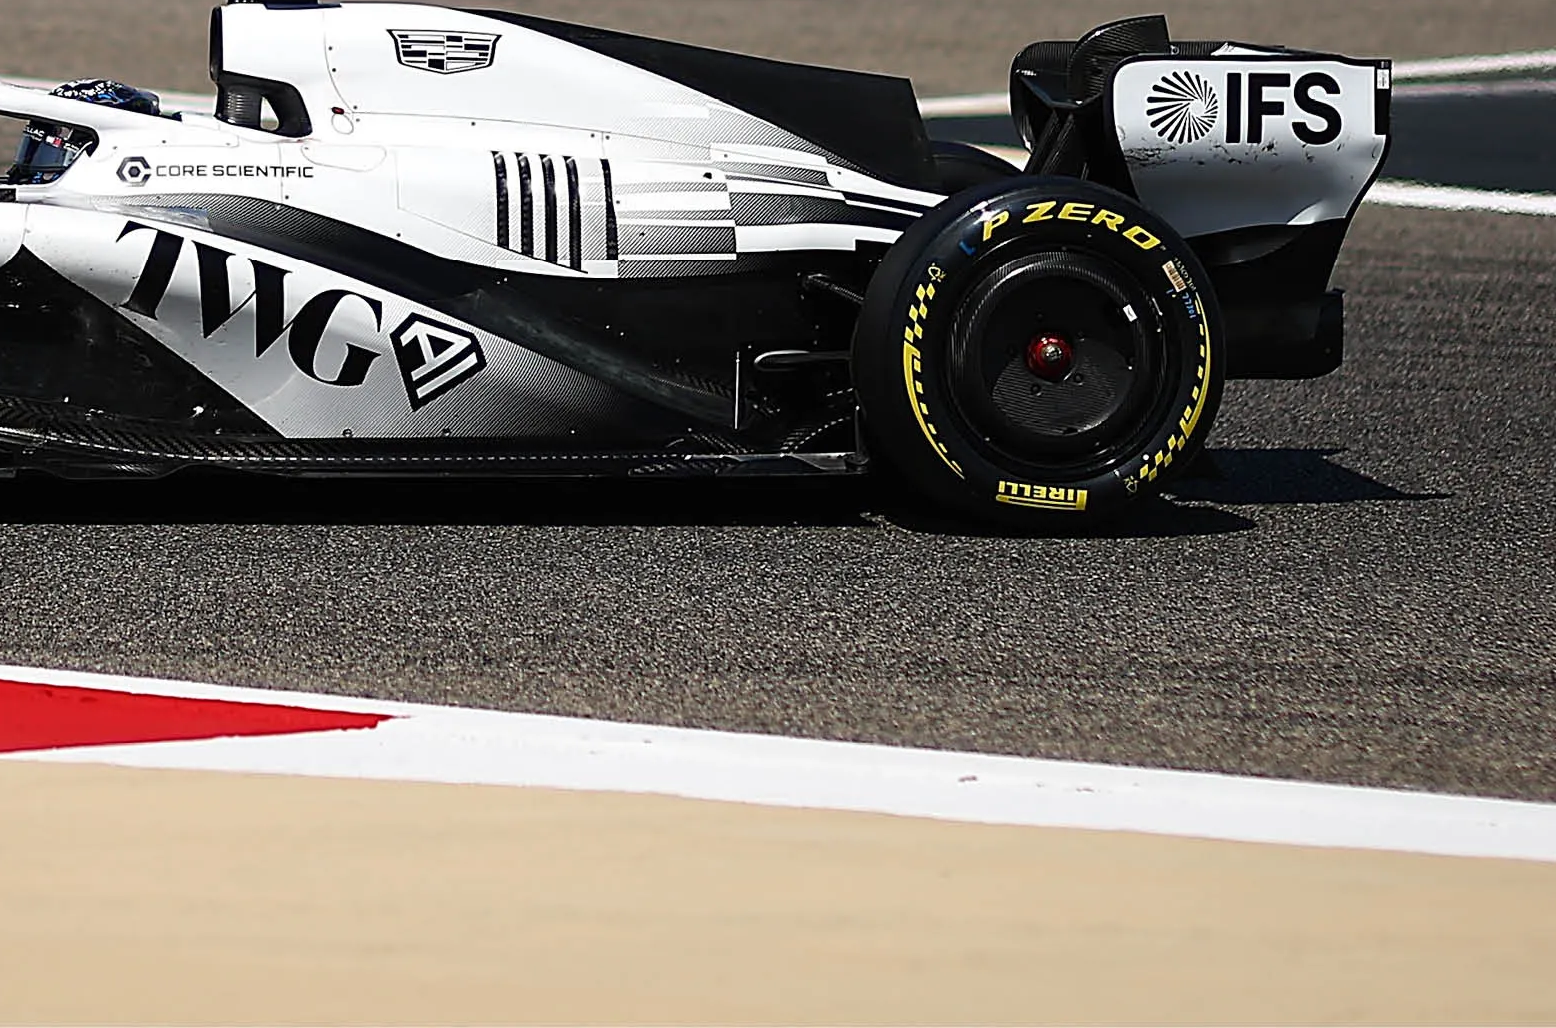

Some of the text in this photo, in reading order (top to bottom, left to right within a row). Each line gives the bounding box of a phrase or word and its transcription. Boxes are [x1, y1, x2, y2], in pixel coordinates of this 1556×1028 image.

[1225, 71, 1343, 146] IFS
[156, 165, 314, 178] CORE SCIENTIFIC
[982, 200, 1162, 251] P ZERO
[115, 220, 383, 387] TWG
[995, 480, 1089, 511] PIRELLI
